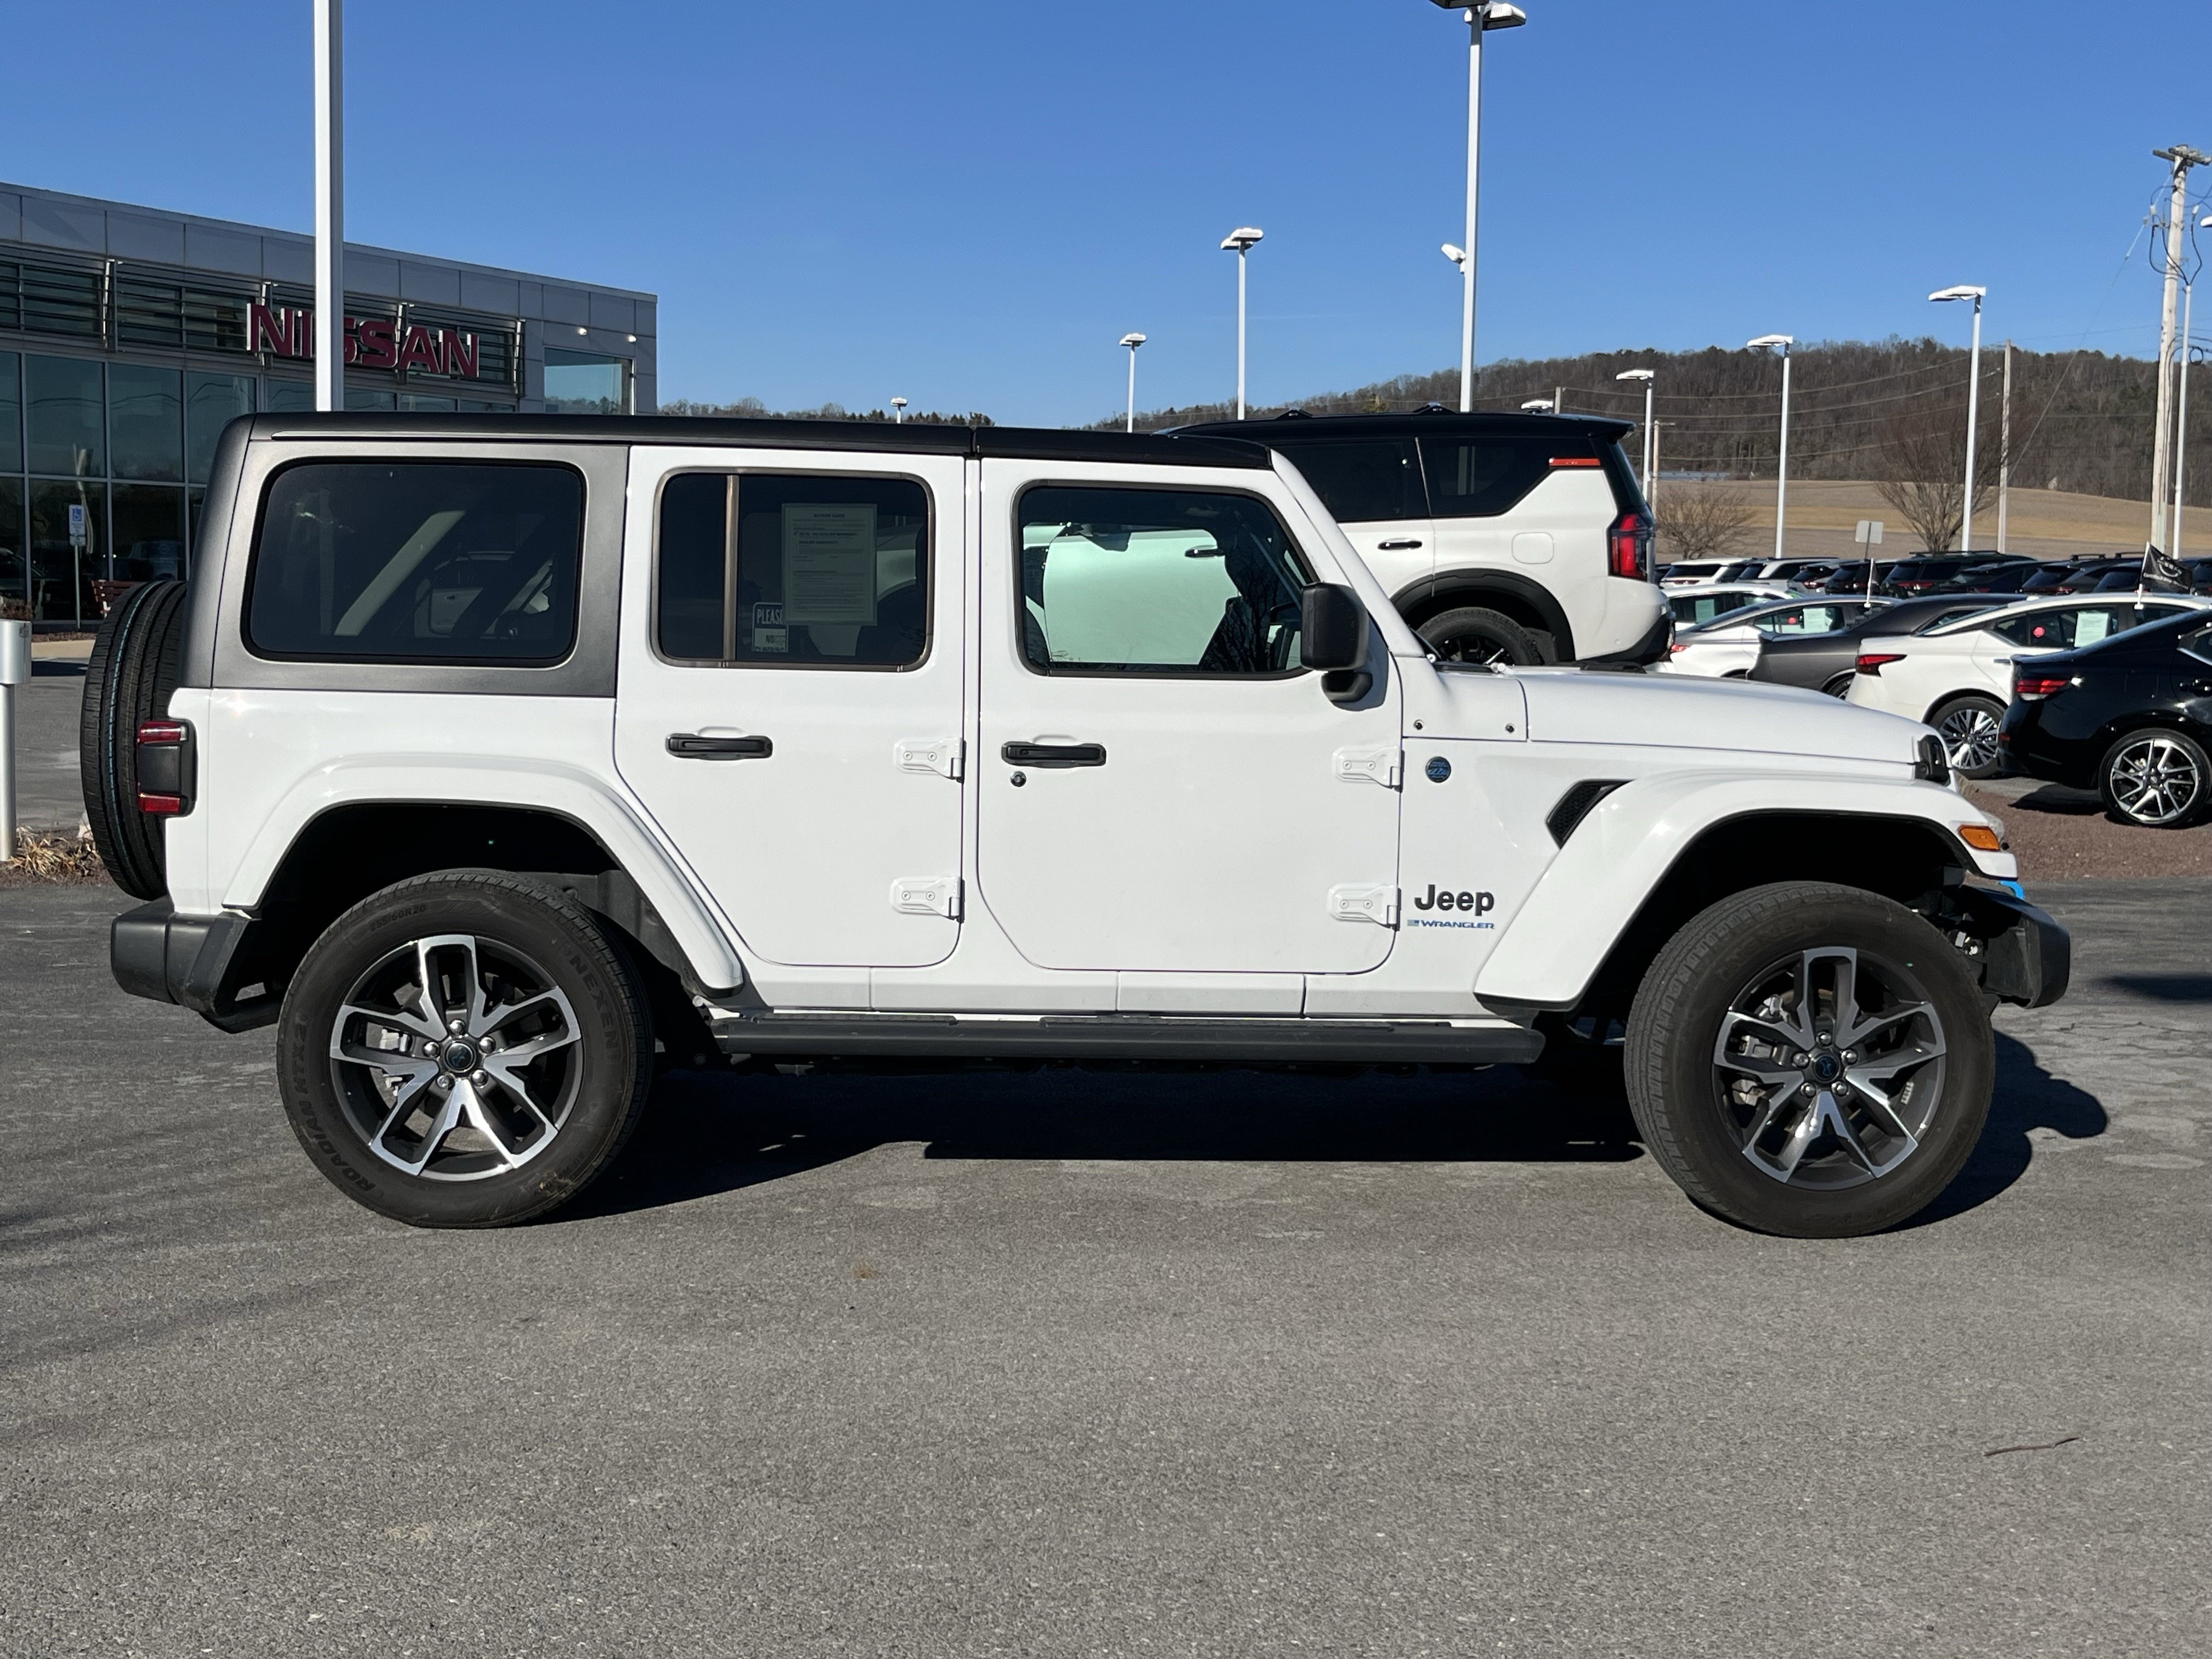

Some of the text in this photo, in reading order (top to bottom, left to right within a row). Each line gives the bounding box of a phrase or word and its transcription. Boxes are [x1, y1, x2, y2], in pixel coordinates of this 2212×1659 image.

[1414, 884, 1494, 917] Jeep
[1420, 919, 1495, 929] WRANGLER
[568, 955, 618, 1049] NEXEN
[291, 1027, 377, 1191] ROADIAN HTX2
